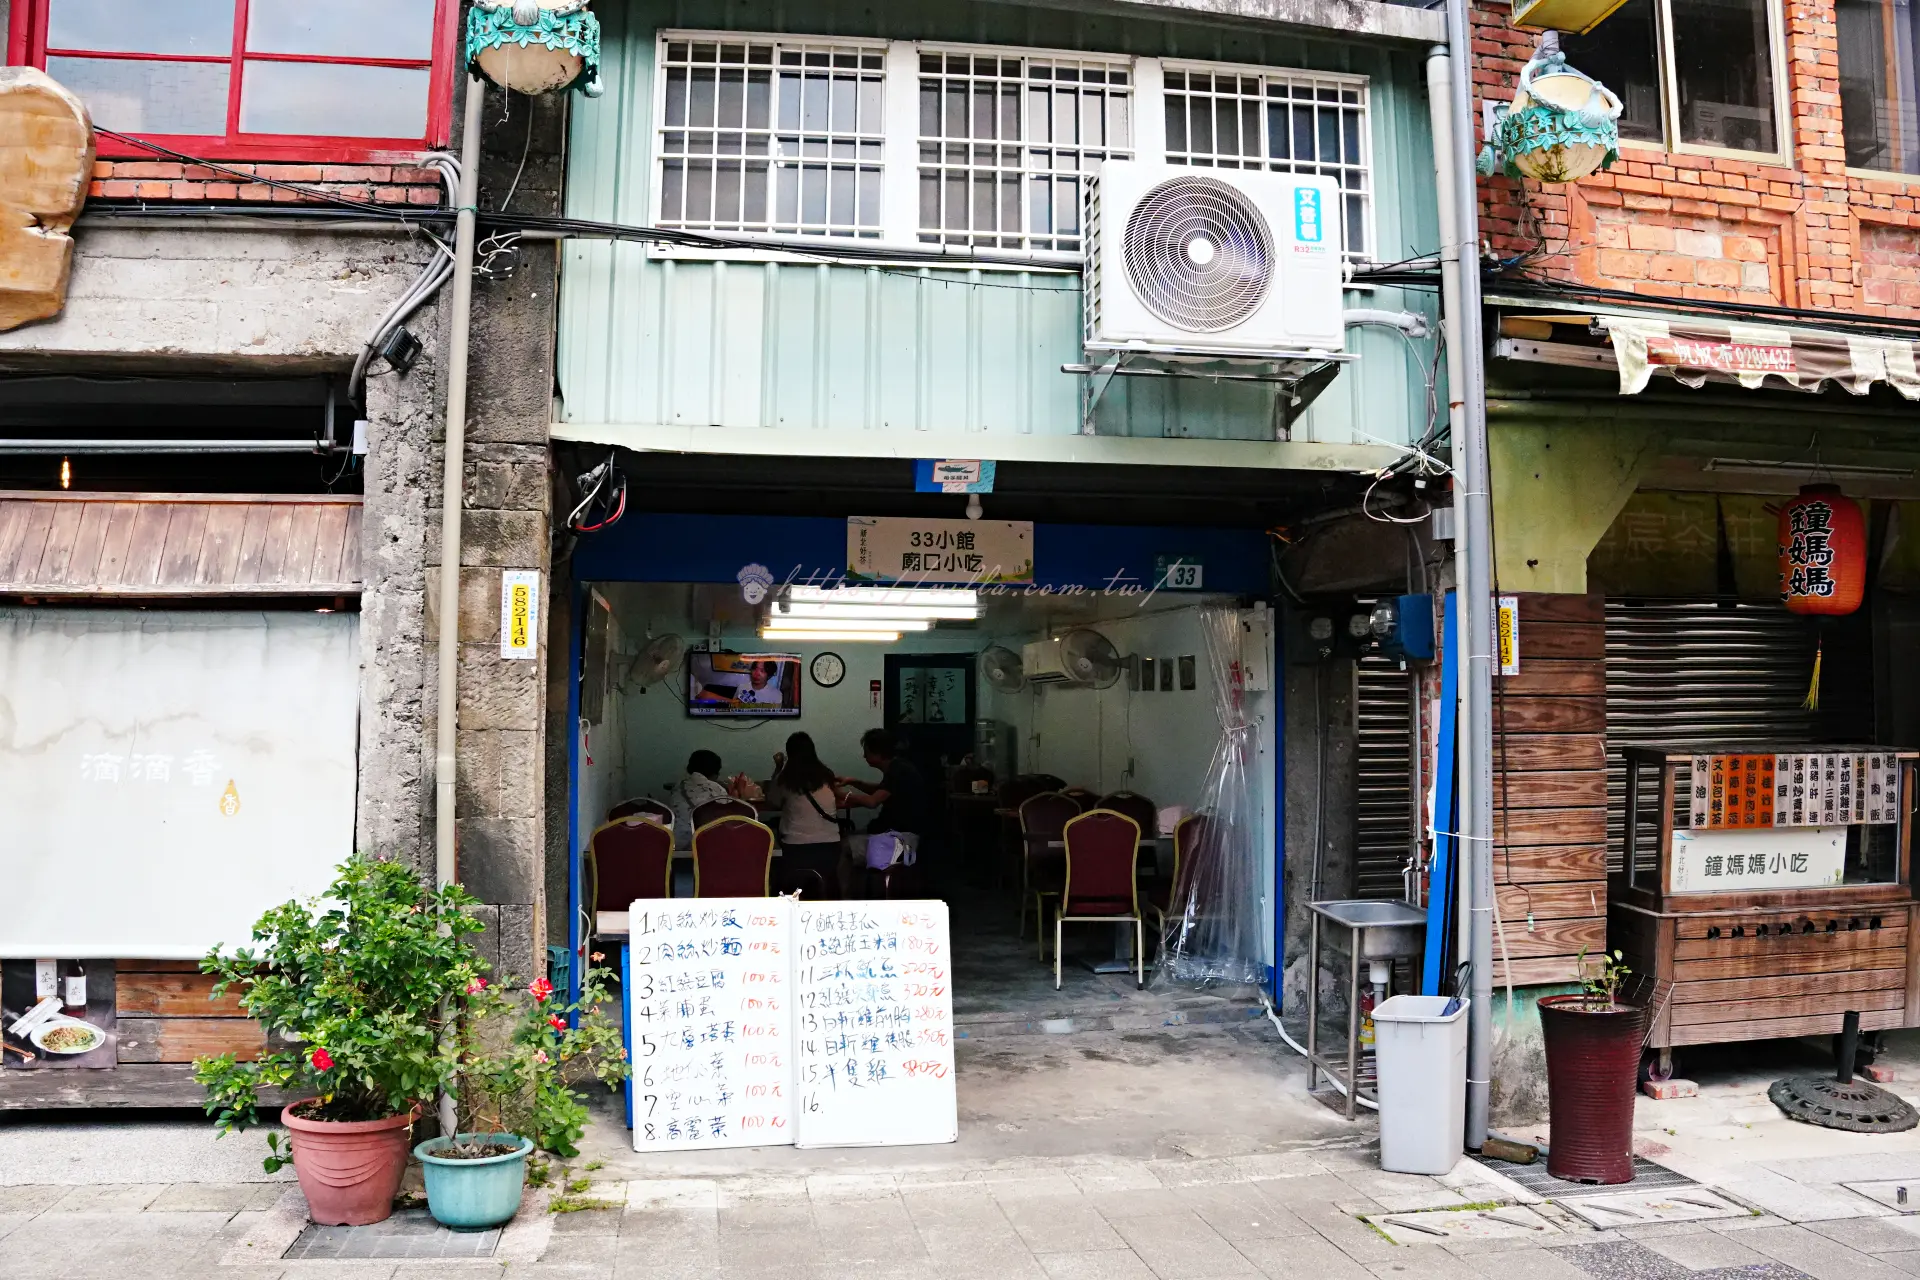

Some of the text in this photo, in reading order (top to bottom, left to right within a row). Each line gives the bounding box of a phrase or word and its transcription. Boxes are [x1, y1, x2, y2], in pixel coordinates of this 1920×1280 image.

[910, 530, 976, 550] 33小館
[1788, 501, 1836, 597] 鐘媽媽
[902, 551, 984, 572] 廟口小吃
[1174, 567, 1196, 585] 33
[514, 587, 526, 647] 582146
[1500, 611, 1510, 664] 582145
[80, 748, 222, 786] 滴滴香
[223, 793, 237, 815] 香
[1704, 851, 1810, 877] 鐘媽媽小吃
[746, 914, 778, 928] 100元
[748, 942, 780, 954] 100元
[901, 936, 939, 955] 180元
[742, 971, 782, 984] 100元
[901, 962, 944, 980] 220元
[903, 982, 946, 1001] 320元
[741, 998, 780, 1011] 100元
[742, 1023, 779, 1037] 100元
[744, 1052, 783, 1067] 100元
[745, 1081, 783, 1097] 100元
[803, 1091, 824, 1114] 16.
[741, 1112, 786, 1129] 100元
